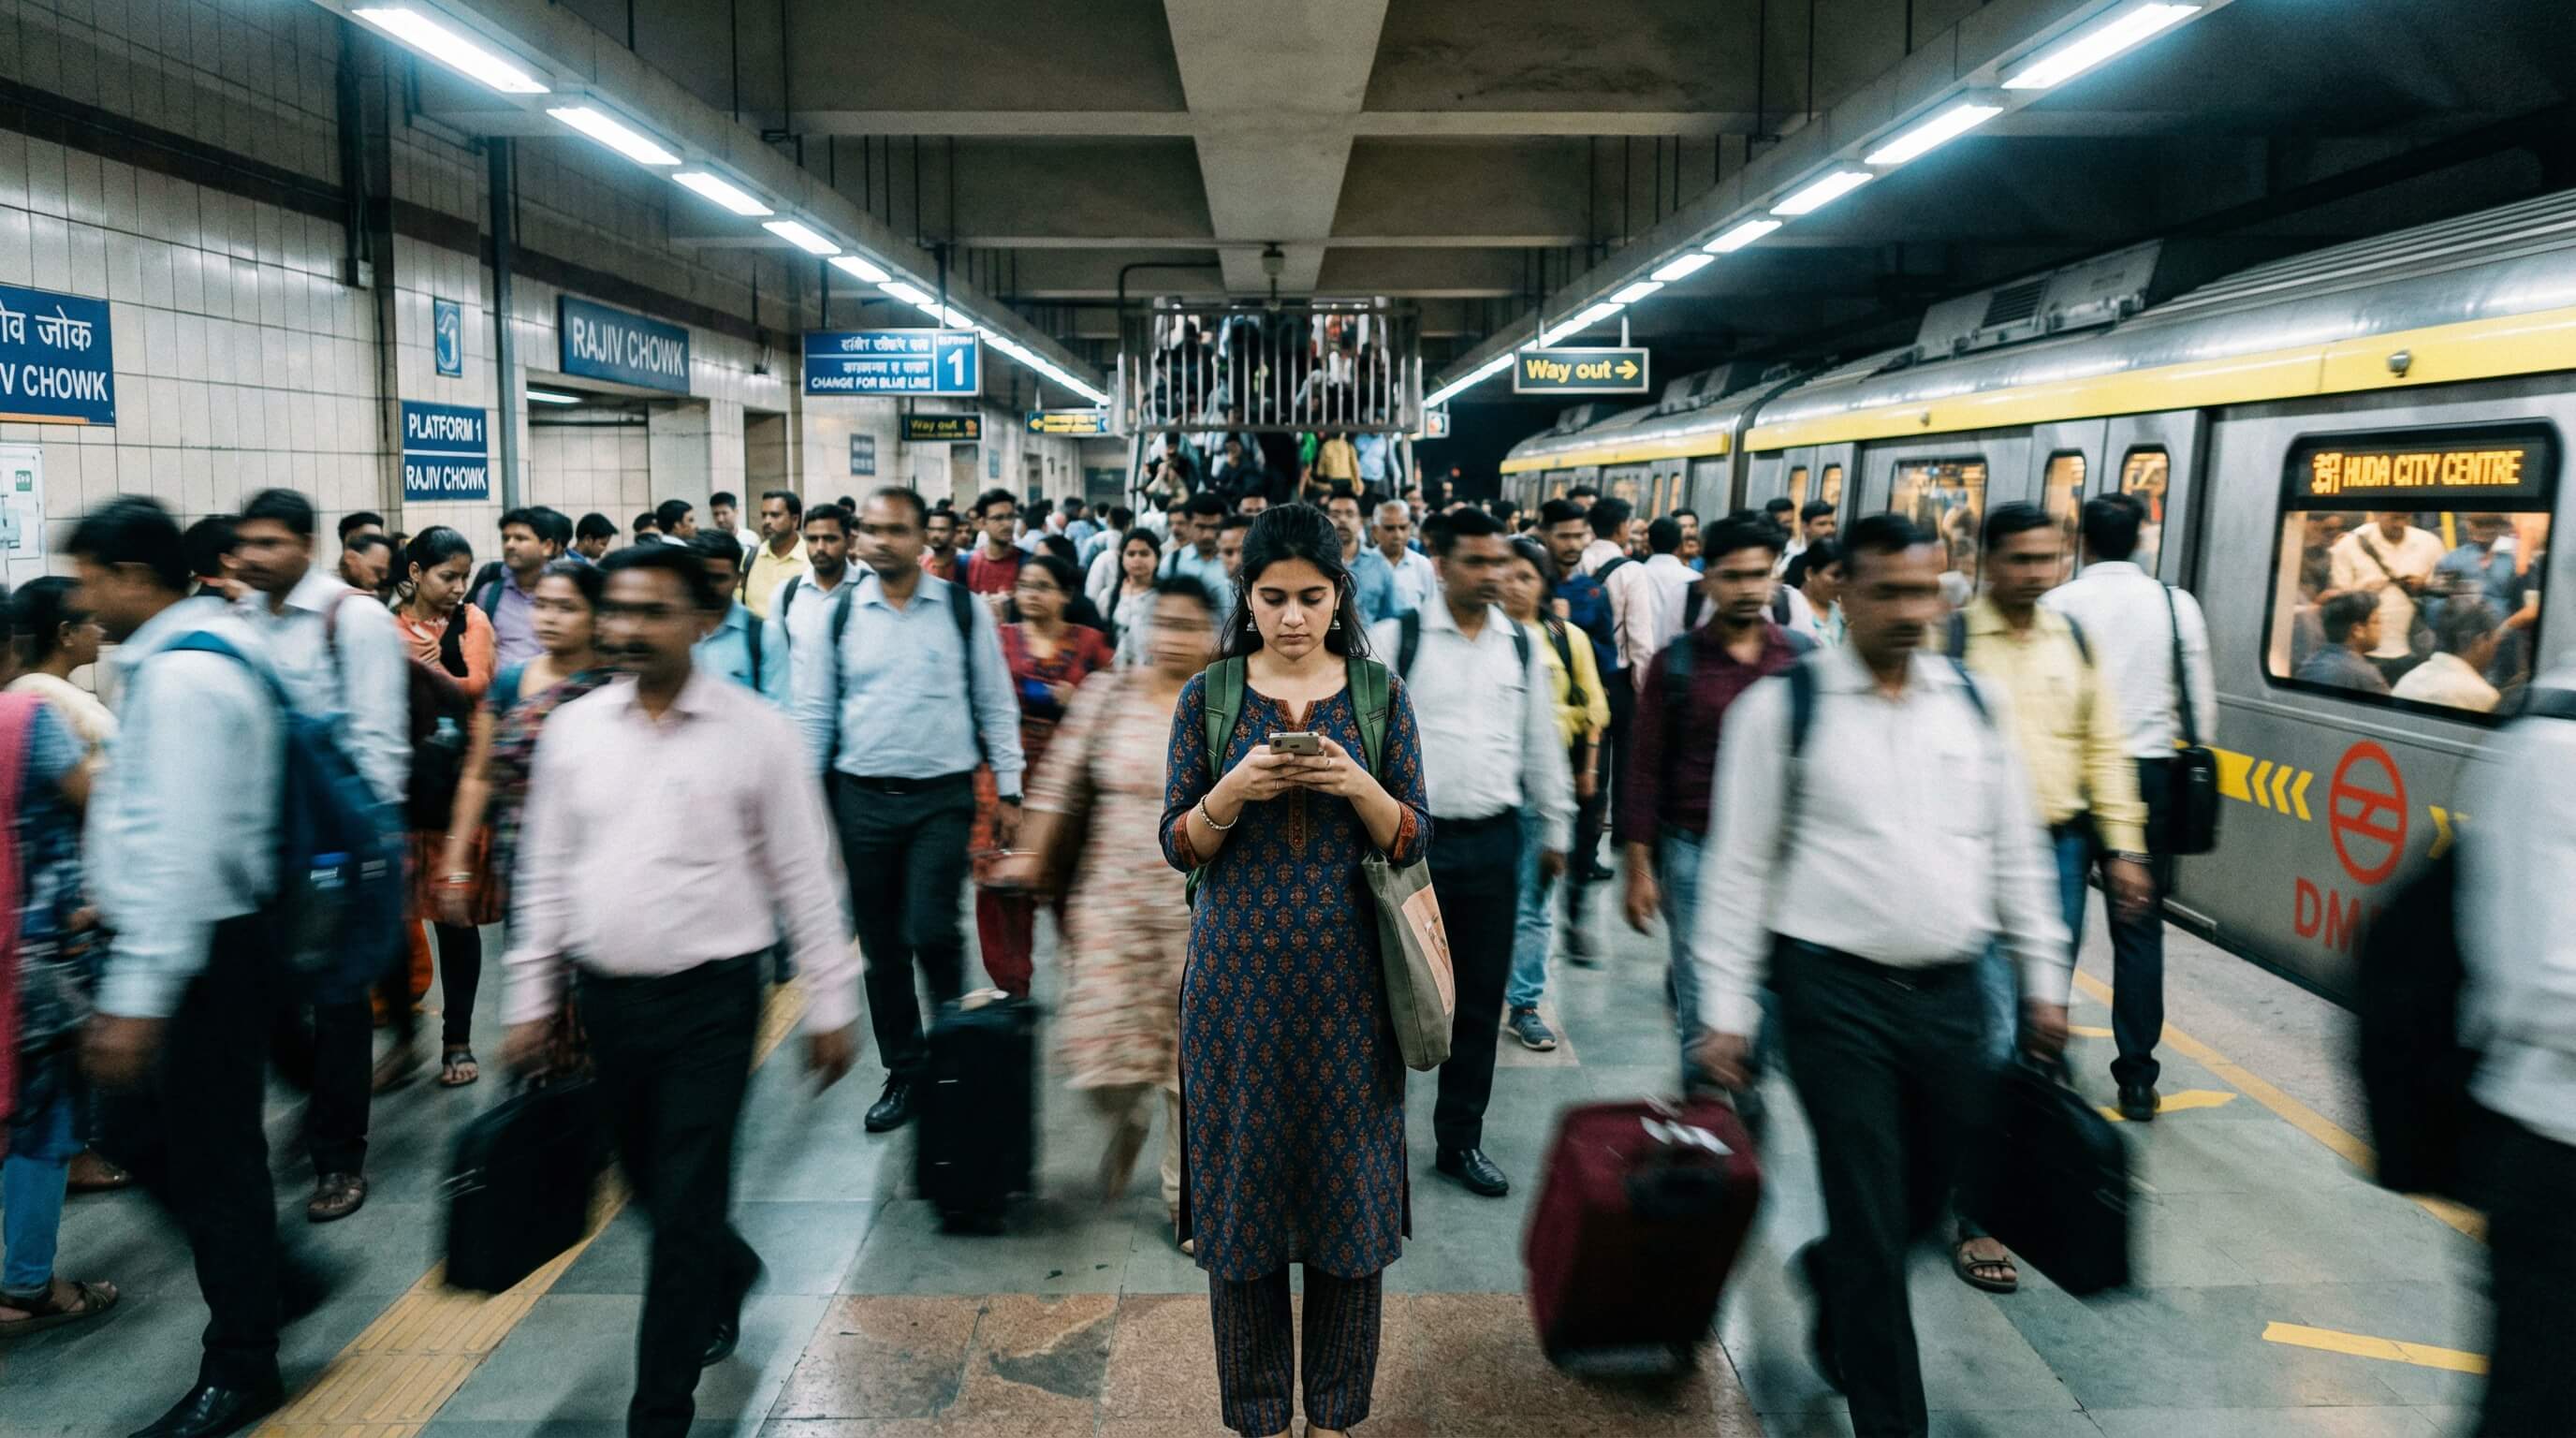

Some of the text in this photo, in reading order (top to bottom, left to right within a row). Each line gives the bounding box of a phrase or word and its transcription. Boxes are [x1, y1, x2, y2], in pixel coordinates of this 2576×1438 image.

[573, 315, 684, 377] RAJIV CHOWK
[22, 364, 109, 402] CHOWK
[856, 377, 877, 389] FOR
[947, 348, 964, 387] 1
[1527, 359, 1612, 384] Way out
[408, 413, 482, 443] PLATFORM 1
[911, 419, 935, 434] Way
[405, 465, 487, 491] RAJIV CHOWK
[2343, 455, 2391, 487] HUDA
[2393, 454, 2440, 486] CITY
[2441, 450, 2525, 485] CENTRE
[2294, 876, 2380, 957] DM
